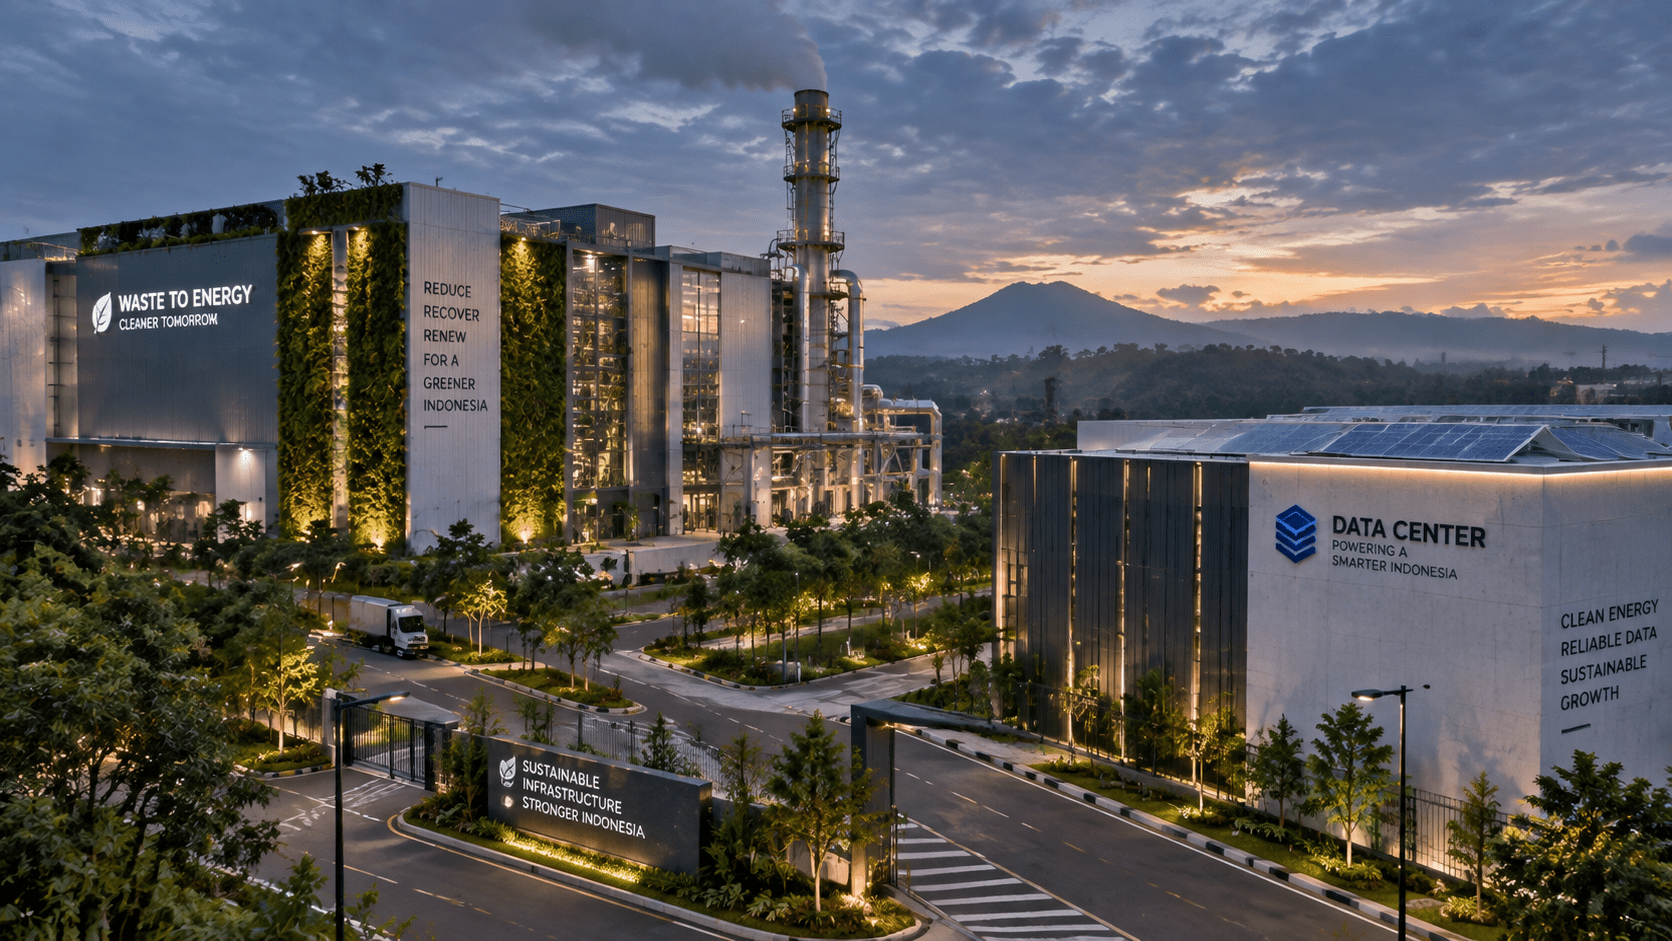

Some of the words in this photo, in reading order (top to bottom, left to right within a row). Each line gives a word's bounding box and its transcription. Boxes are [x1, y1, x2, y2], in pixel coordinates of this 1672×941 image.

[118, 292, 165, 312] WASTE
[169, 290, 188, 309] TO
[193, 284, 253, 307] ENERGY
[424, 281, 472, 298] REDUCE
[119, 316, 159, 331] CLEANER
[424, 305, 480, 322] RECOVER
[424, 329, 466, 343] RENEW
[424, 353, 448, 367] FOR
[451, 354, 459, 367] A
[423, 376, 475, 390] GREENER
[424, 399, 488, 412] INDONESIA
[1332, 515, 1387, 538] DATA
[1393, 520, 1486, 548] CENTER
[1332, 539, 1395, 557] POWERING
[1398, 546, 1408, 558] A
[1332, 555, 1387, 572] SMARTER
[1390, 562, 1458, 580] INDONESIA
[1561, 608, 1605, 629] CLEAN
[1609, 599, 1659, 621] ENERGY
[1561, 632, 1622, 657] RELIABLE
[1626, 626, 1657, 645] DATA
[1561, 654, 1647, 685] SUSTAINABLE
[1560, 685, 1619, 711] GROWTH
[522, 759, 600, 790] SUSTAINABLE
[522, 777, 622, 815] INFRASTRUCTURE
[522, 796, 579, 822] STRONGER
[582, 811, 645, 839] INDONESIA
